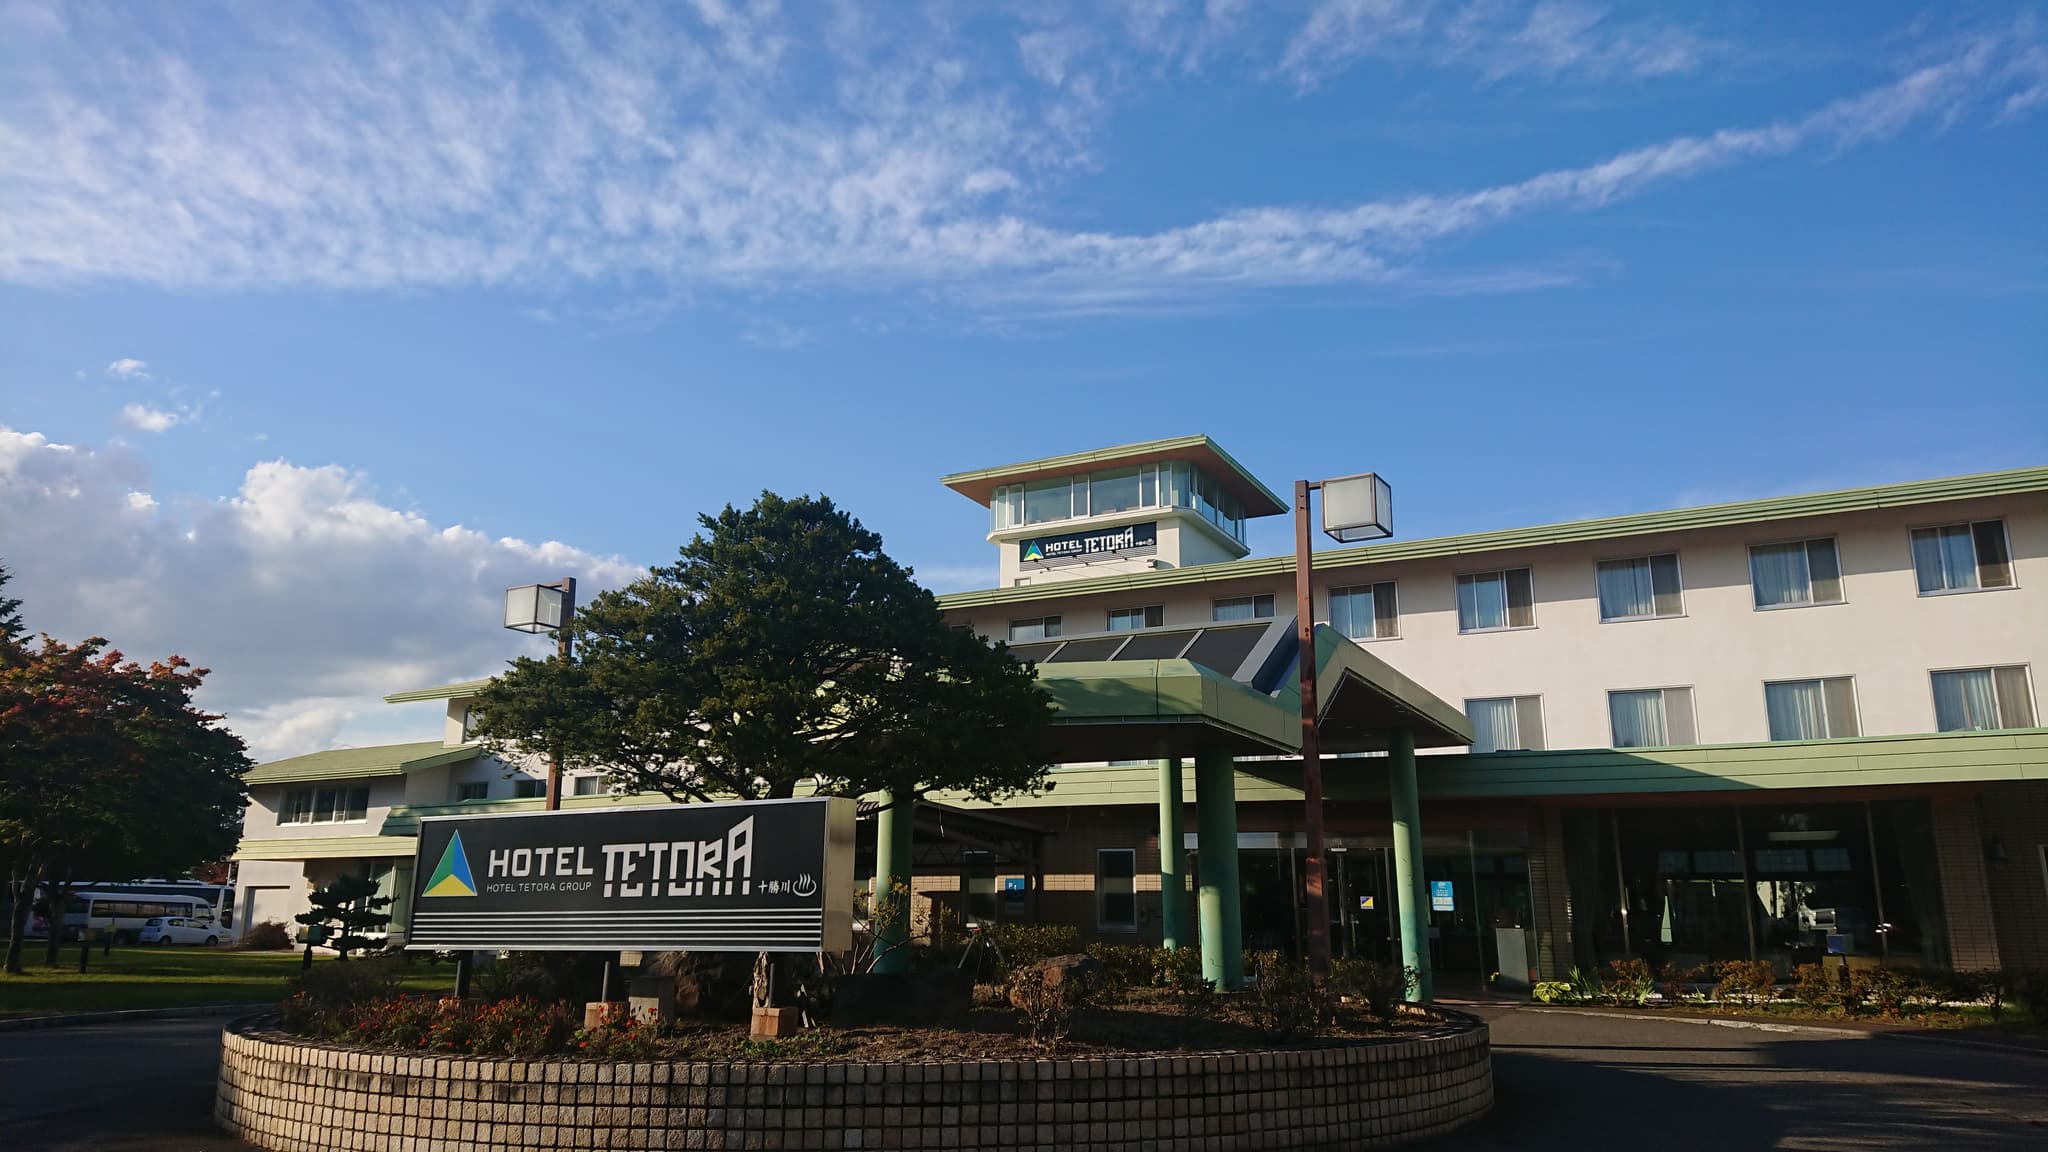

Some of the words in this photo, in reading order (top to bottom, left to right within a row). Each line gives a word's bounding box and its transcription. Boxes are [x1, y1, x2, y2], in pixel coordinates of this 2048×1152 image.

[1045, 540, 1082, 553] HOTEL
[1084, 526, 1133, 553] TETORA
[488, 846, 594, 877] HOTEL
[602, 815, 754, 897] TETORA
[486, 883, 516, 893] HOTEL
[519, 882, 556, 892] TETORA
[560, 881, 592, 891] GROUP
[757, 880, 791, 895] 十勝川
